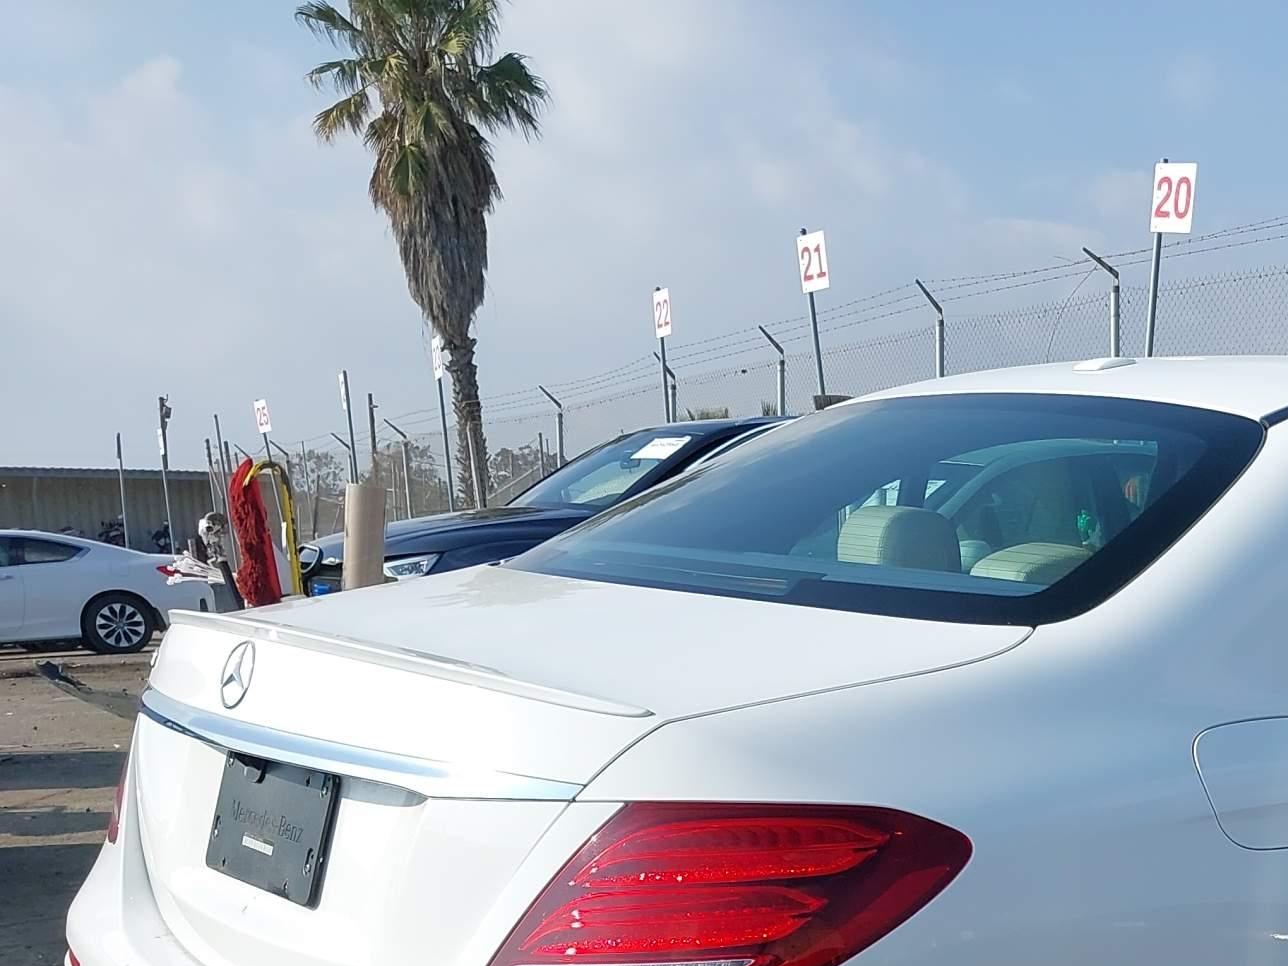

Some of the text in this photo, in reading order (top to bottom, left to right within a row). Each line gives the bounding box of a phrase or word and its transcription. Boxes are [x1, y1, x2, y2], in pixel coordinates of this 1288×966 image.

[1154, 176, 1191, 219] 20
[801, 243, 826, 282] 21
[655, 299, 670, 329] 22
[256, 406, 269, 426] 25
